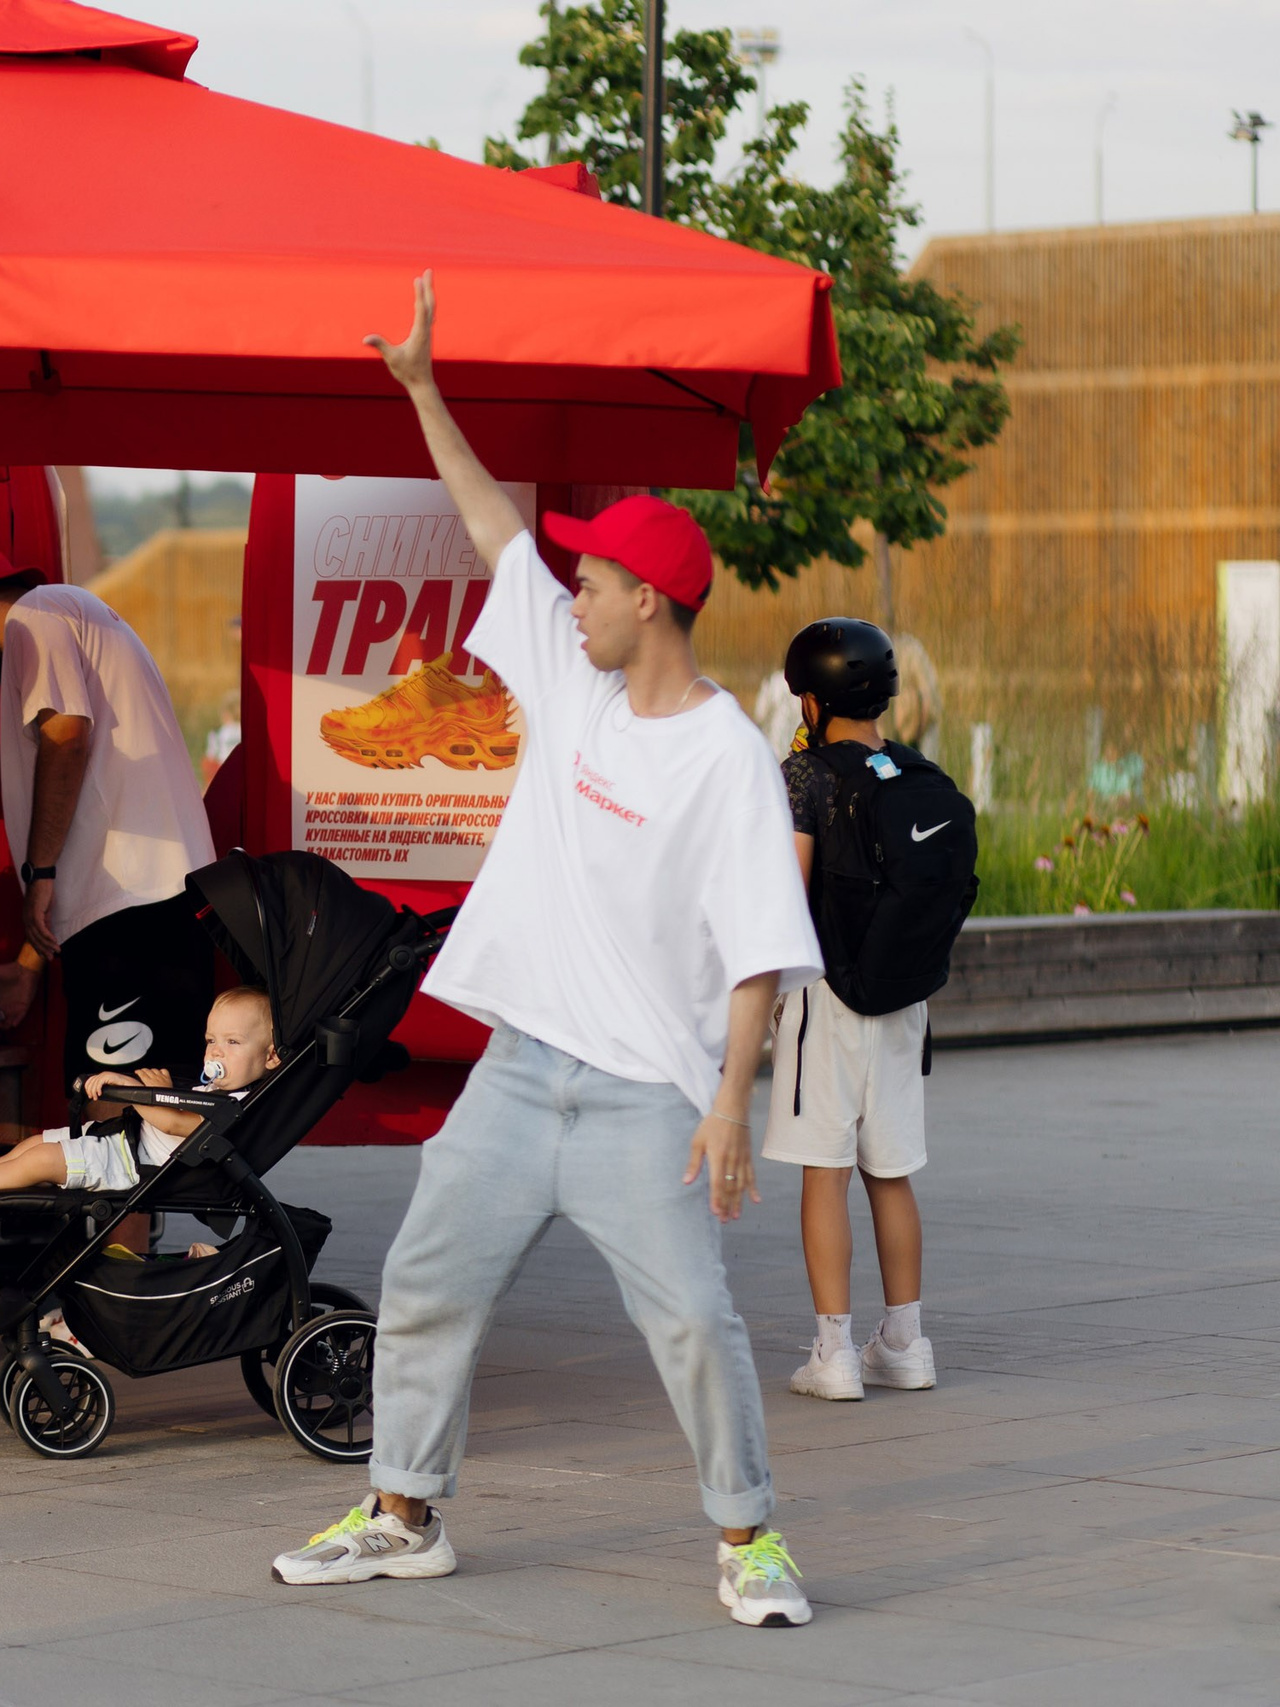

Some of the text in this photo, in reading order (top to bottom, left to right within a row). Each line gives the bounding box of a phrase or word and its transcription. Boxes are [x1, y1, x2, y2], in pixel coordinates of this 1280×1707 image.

[314, 514, 490, 578] СНИКЕ
[305, 791, 314, 805] У
[314, 791, 336, 805] НАС
[336, 792, 380, 806] МОЖНО
[380, 793, 423, 807] КУПИТЬ
[576, 779, 648, 828] Маркет
[305, 810, 369, 824] КРОССОВКИ
[369, 811, 394, 825] ИЛИ
[393, 812, 451, 826] ПРИНЕСТИ
[305, 828, 486, 848] КУПЛЕННЫЕ НА ЯНДЕКС МАРКЕТЕ,
[316, 847, 392, 862] ЗАКАСТОМИТЬ
[393, 849, 410, 862] ИХ
